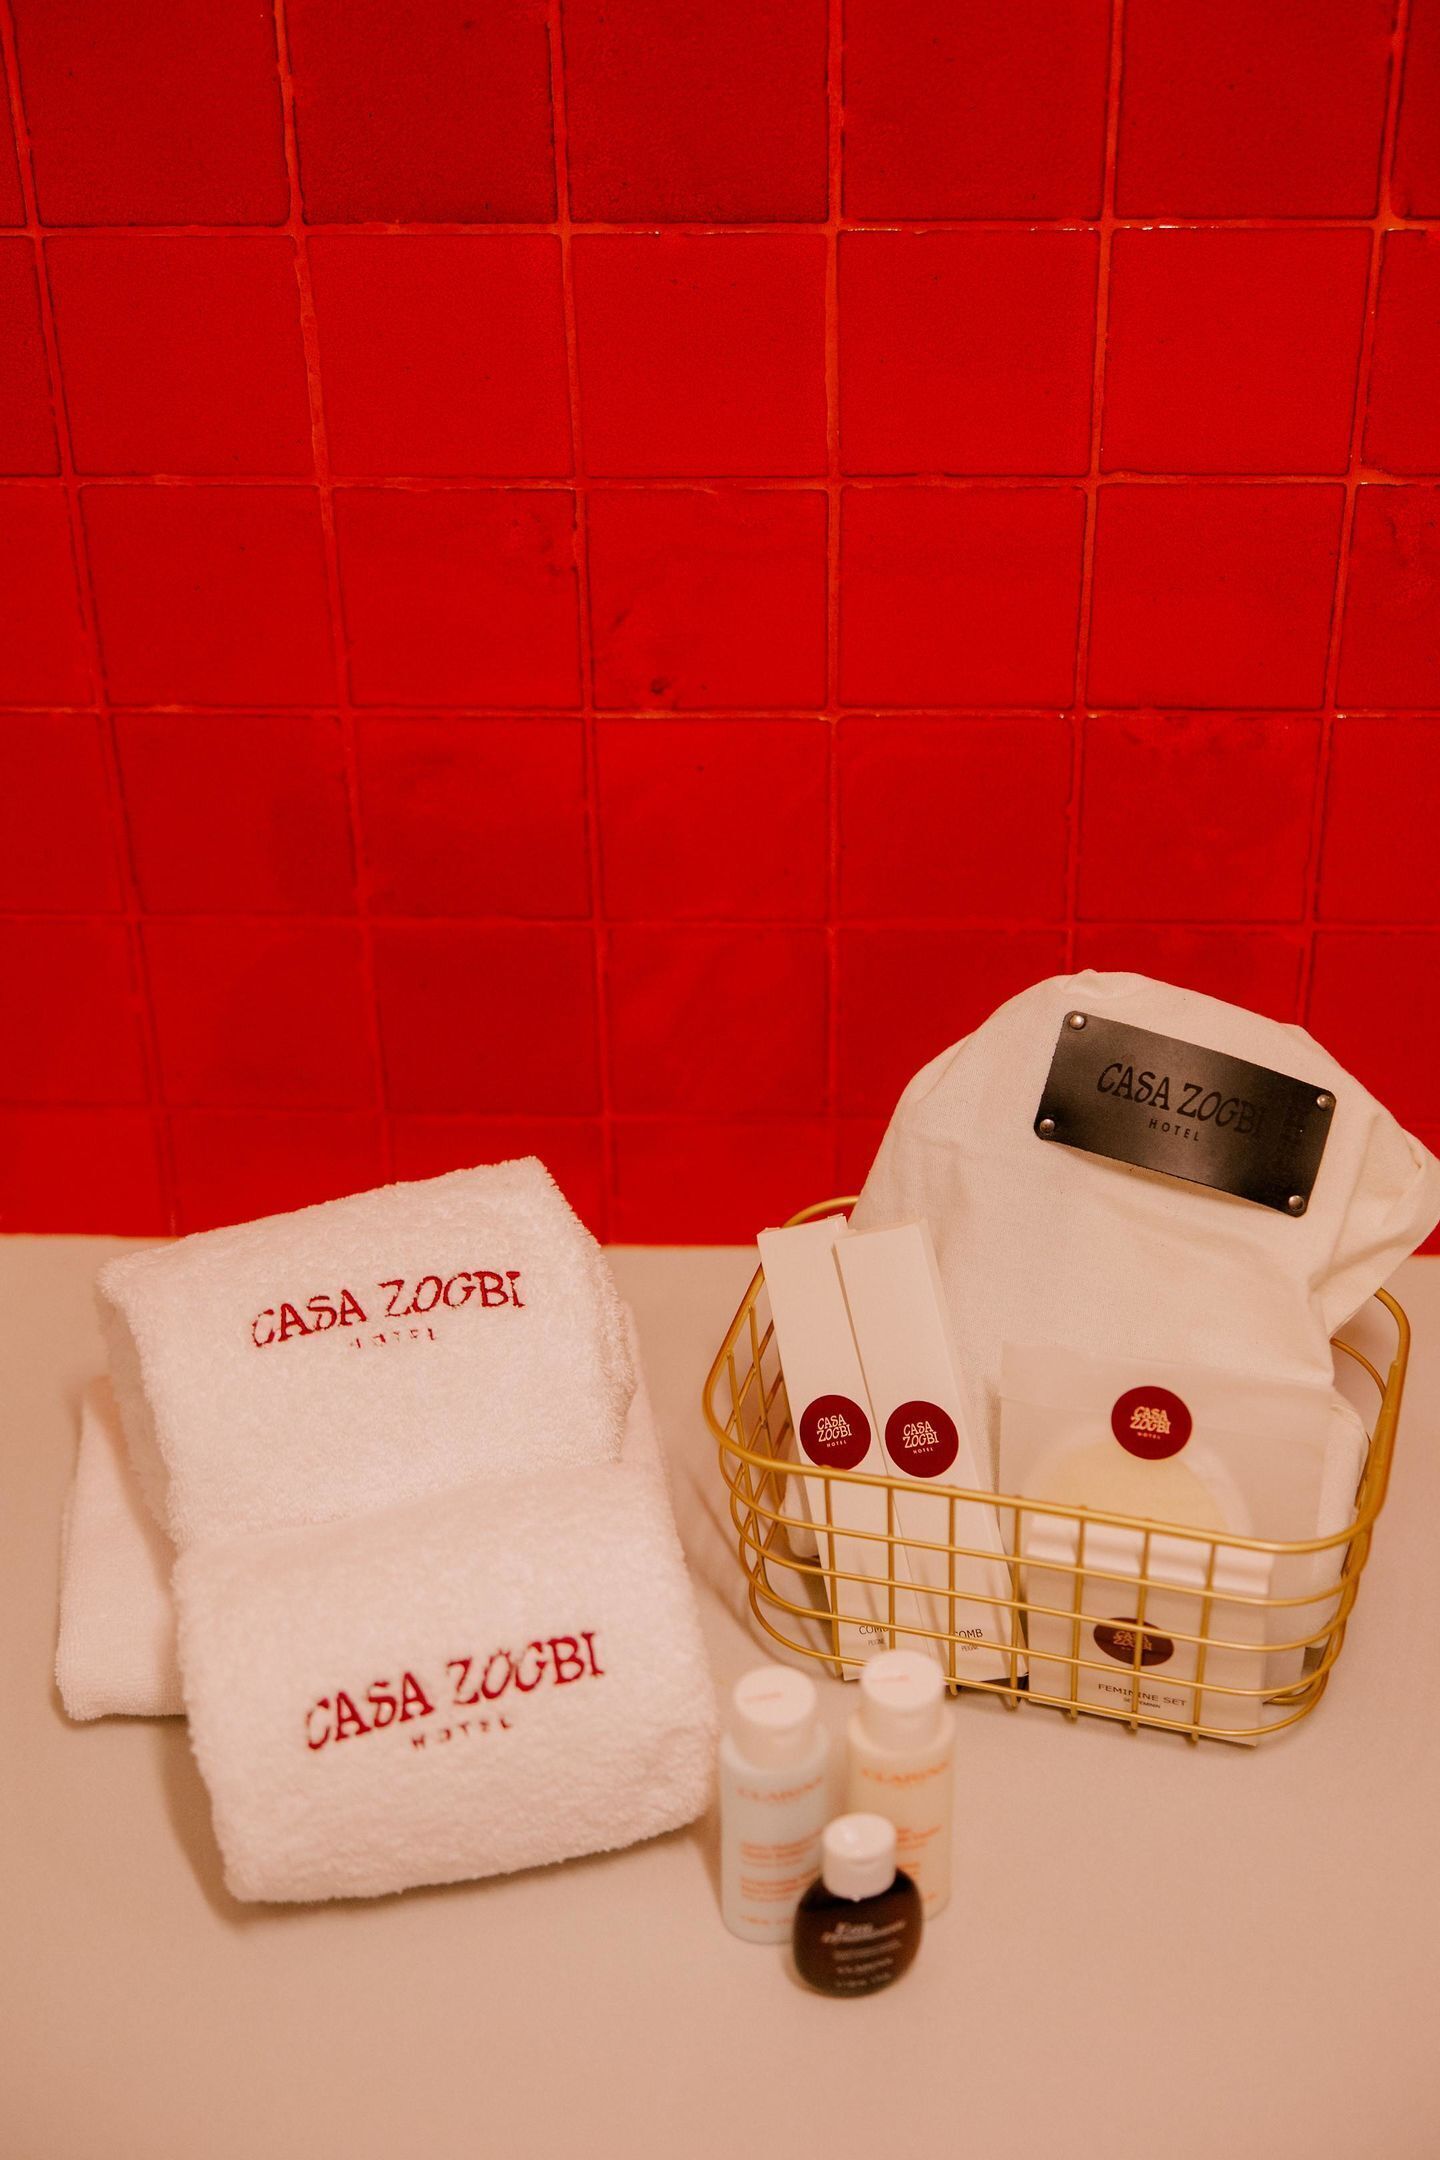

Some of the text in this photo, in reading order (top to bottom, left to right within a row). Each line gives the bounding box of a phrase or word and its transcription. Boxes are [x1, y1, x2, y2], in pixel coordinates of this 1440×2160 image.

[1096, 1062, 1170, 1110] CASA
[1149, 1118, 1200, 1141] HOTEL
[252, 1271, 525, 1348] CASA ZOGBI
[817, 1413, 847, 1430] CASA
[1133, 1406, 1168, 1422] CASA
[816, 1424, 852, 1442] ZOGBI
[903, 1421, 934, 1437] CASA
[1130, 1416, 1171, 1434] ZOGBI
[902, 1431, 939, 1448] ZOGBI
[954, 1628, 984, 1639] OMB
[305, 1631, 605, 1750] CASA ZOGBI
[1163, 1696, 1186, 1706] SET
